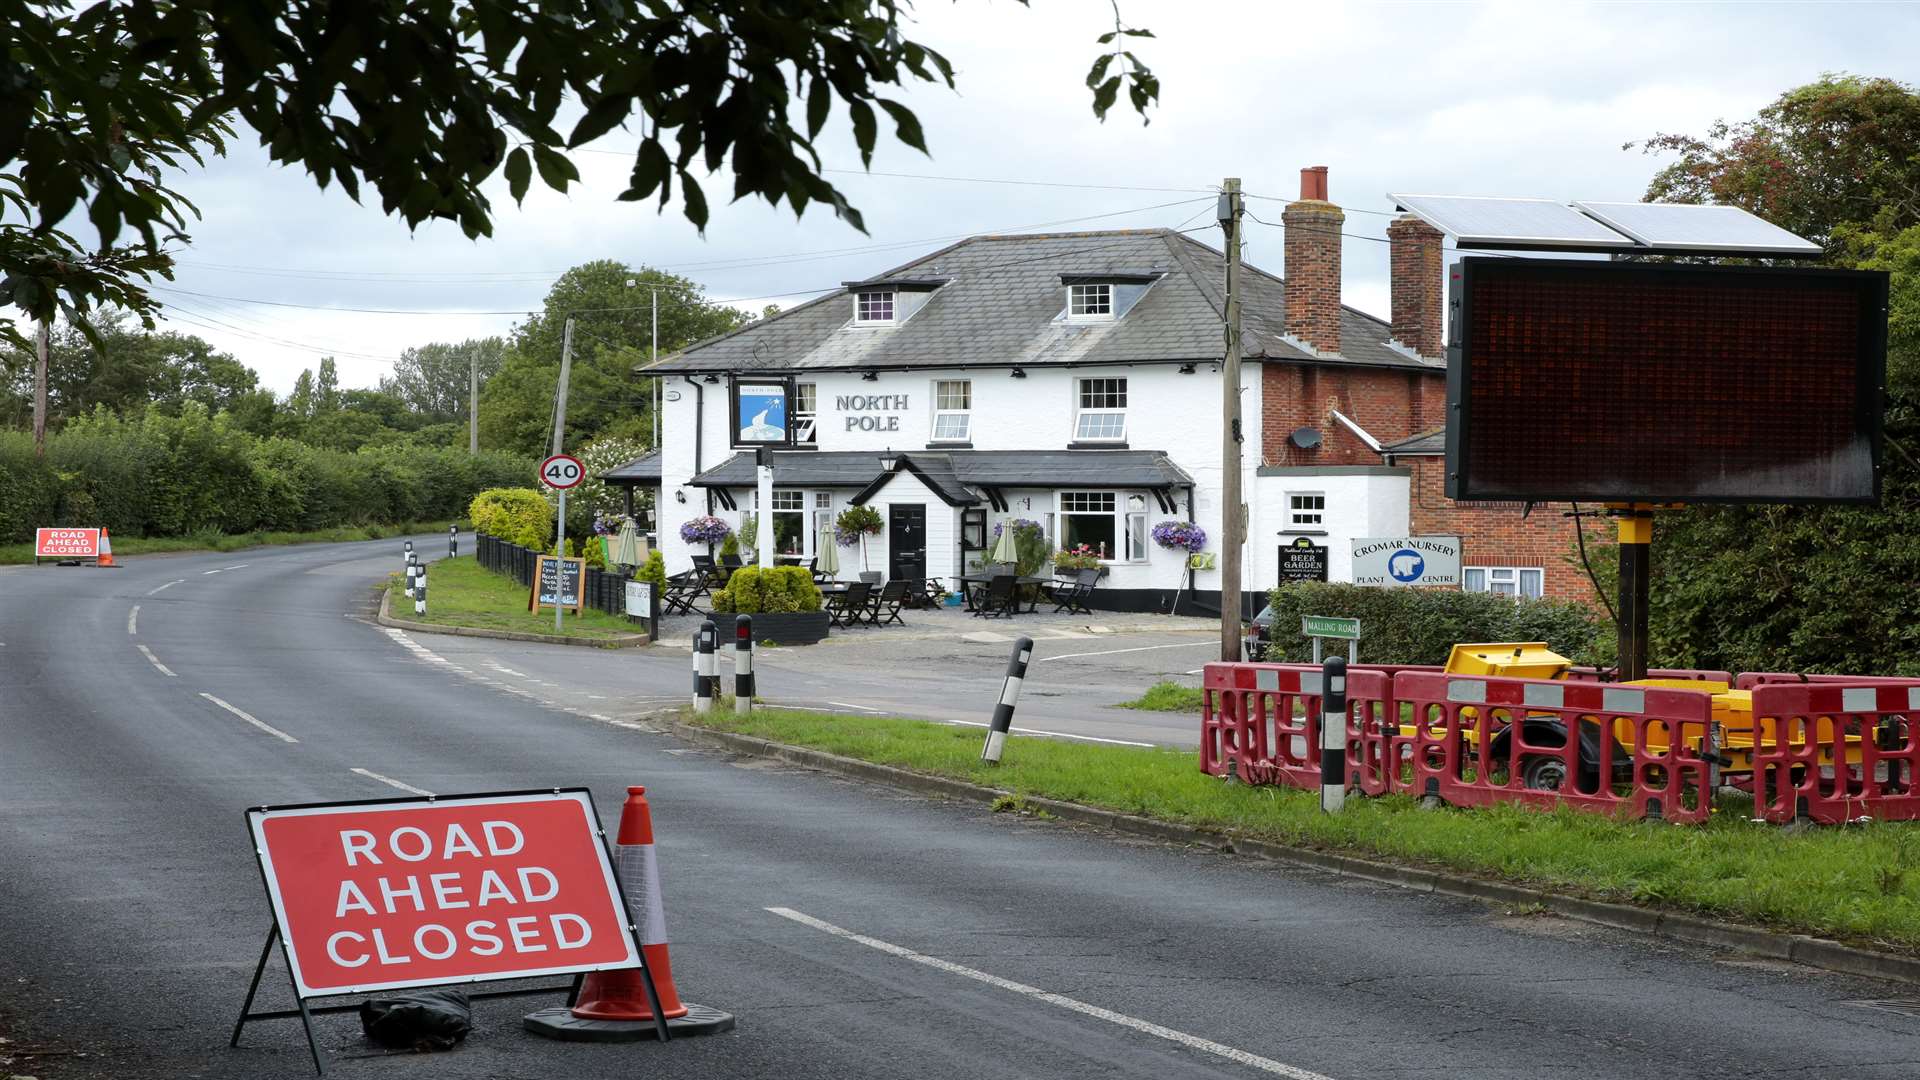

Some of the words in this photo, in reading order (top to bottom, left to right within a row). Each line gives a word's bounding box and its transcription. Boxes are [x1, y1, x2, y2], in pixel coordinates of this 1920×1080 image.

[836, 394, 909, 411] NORTH
[845, 416, 899, 432] POLE
[546, 464, 579, 479] 40
[51, 531, 86, 539] ROAD
[1353, 540, 1404, 558] CROMAR
[1408, 540, 1457, 558] NURSERY
[1283, 561, 1322, 569] GARDEN
[1356, 576, 1385, 584] PLANT
[1422, 575, 1455, 583] CENTRE
[1307, 621, 1336, 632] MALLING
[1338, 623, 1357, 633] ROAD
[339, 820, 524, 867] ROAD
[335, 866, 560, 918] AHEAD
[326, 913, 592, 968] CLOSED
